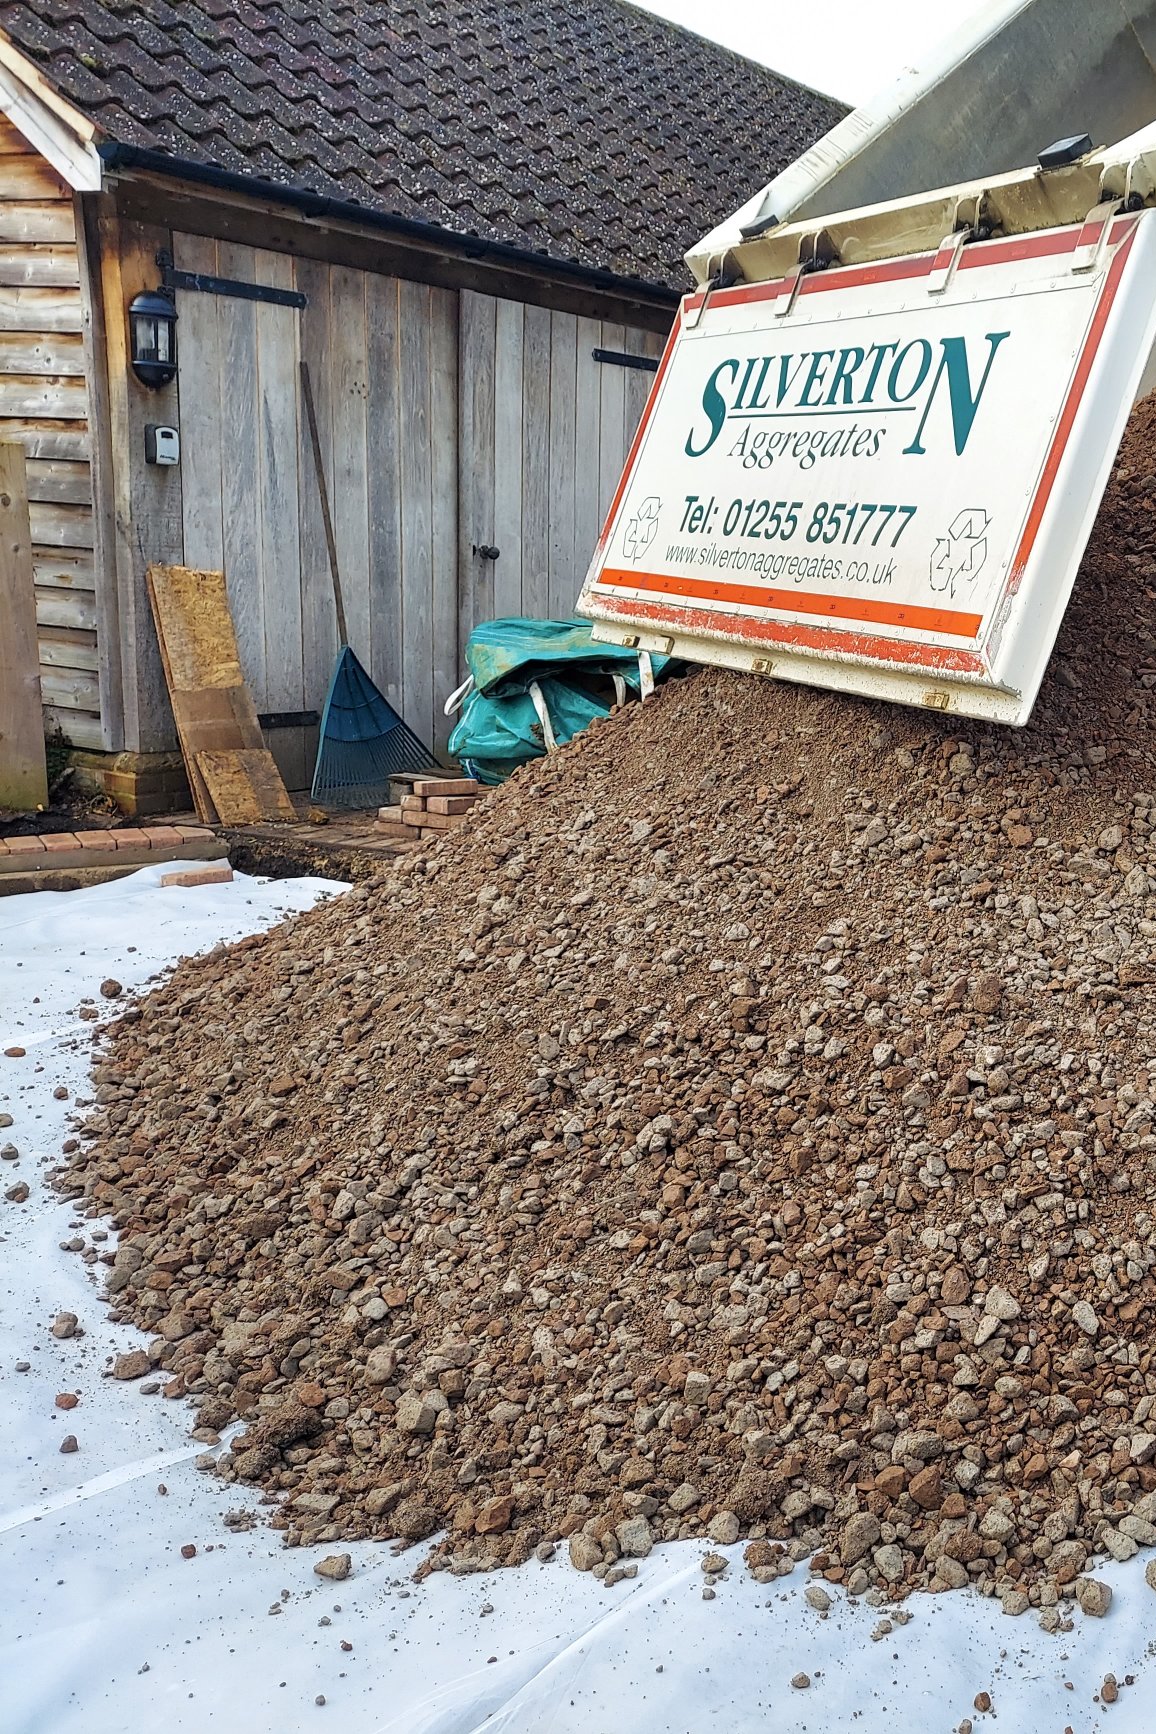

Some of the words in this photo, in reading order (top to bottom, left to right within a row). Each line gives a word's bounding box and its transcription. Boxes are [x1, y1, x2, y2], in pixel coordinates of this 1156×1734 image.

[684, 331, 1011, 458] SILVERTON
[726, 422, 887, 470] Aggregates
[679, 495, 719, 535] Tel:
[722, 498, 803, 541] 01255
[805, 501, 917, 548] 851777
[664, 541, 897, 586] www.silvertonaggregates.co.uk
